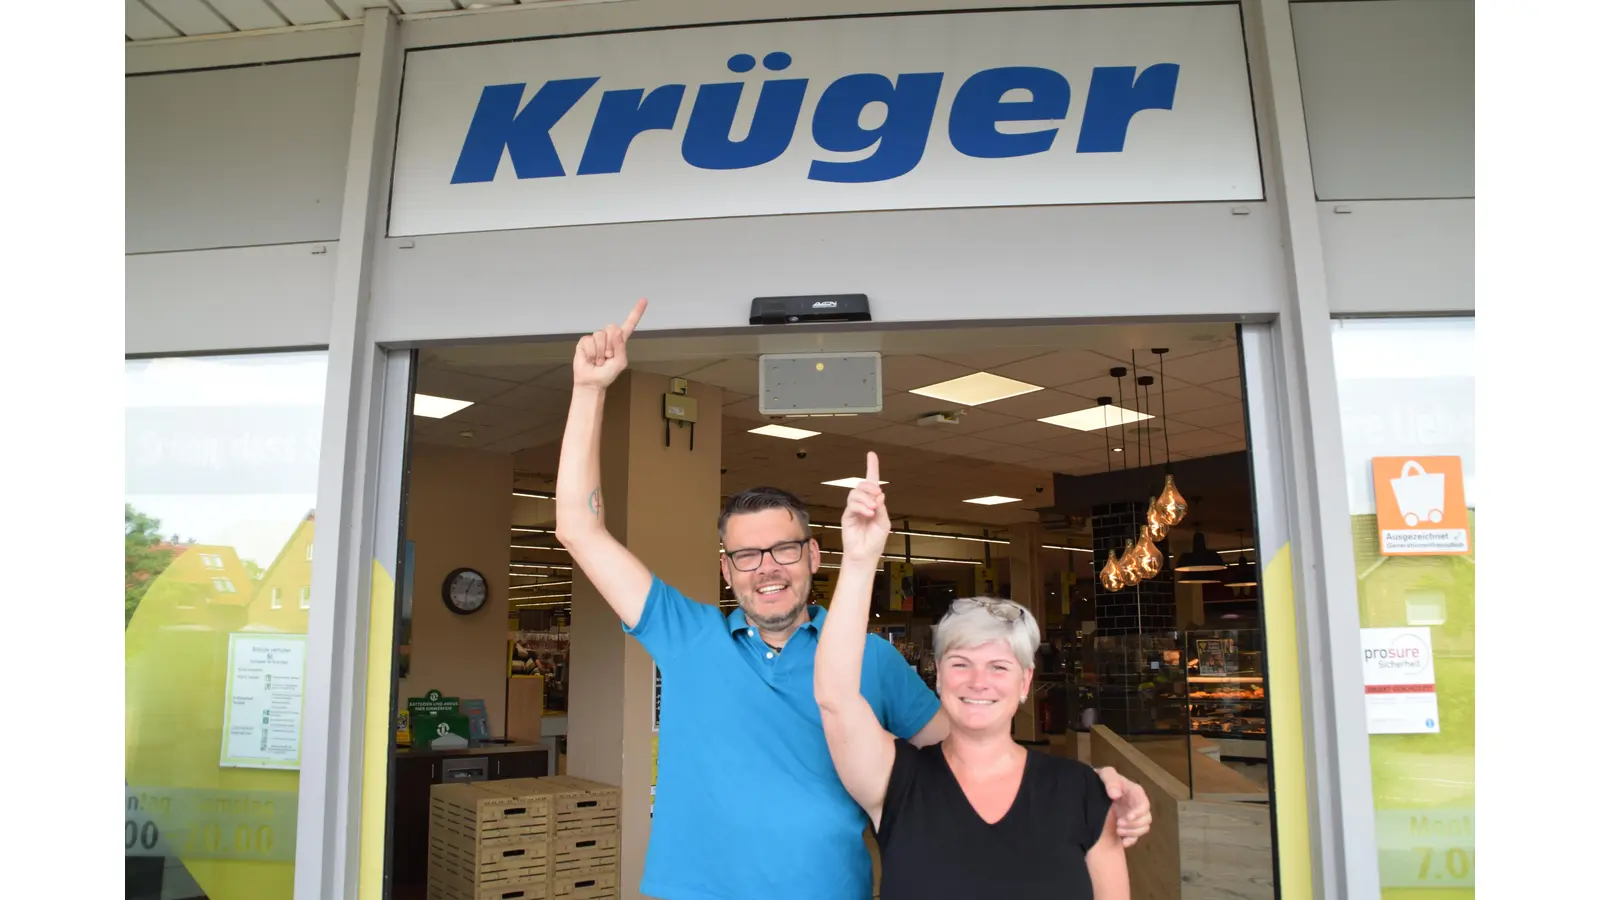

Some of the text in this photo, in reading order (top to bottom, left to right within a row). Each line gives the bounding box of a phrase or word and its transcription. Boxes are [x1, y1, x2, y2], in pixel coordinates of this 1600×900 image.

[450, 51, 1181, 185] Krüger
[1386, 532, 1449, 541] Ausgezeichnet
[1364, 647, 1420, 662] prosure
[1378, 660, 1421, 669] Sicherheit
[1411, 846, 1474, 880] 7.0
